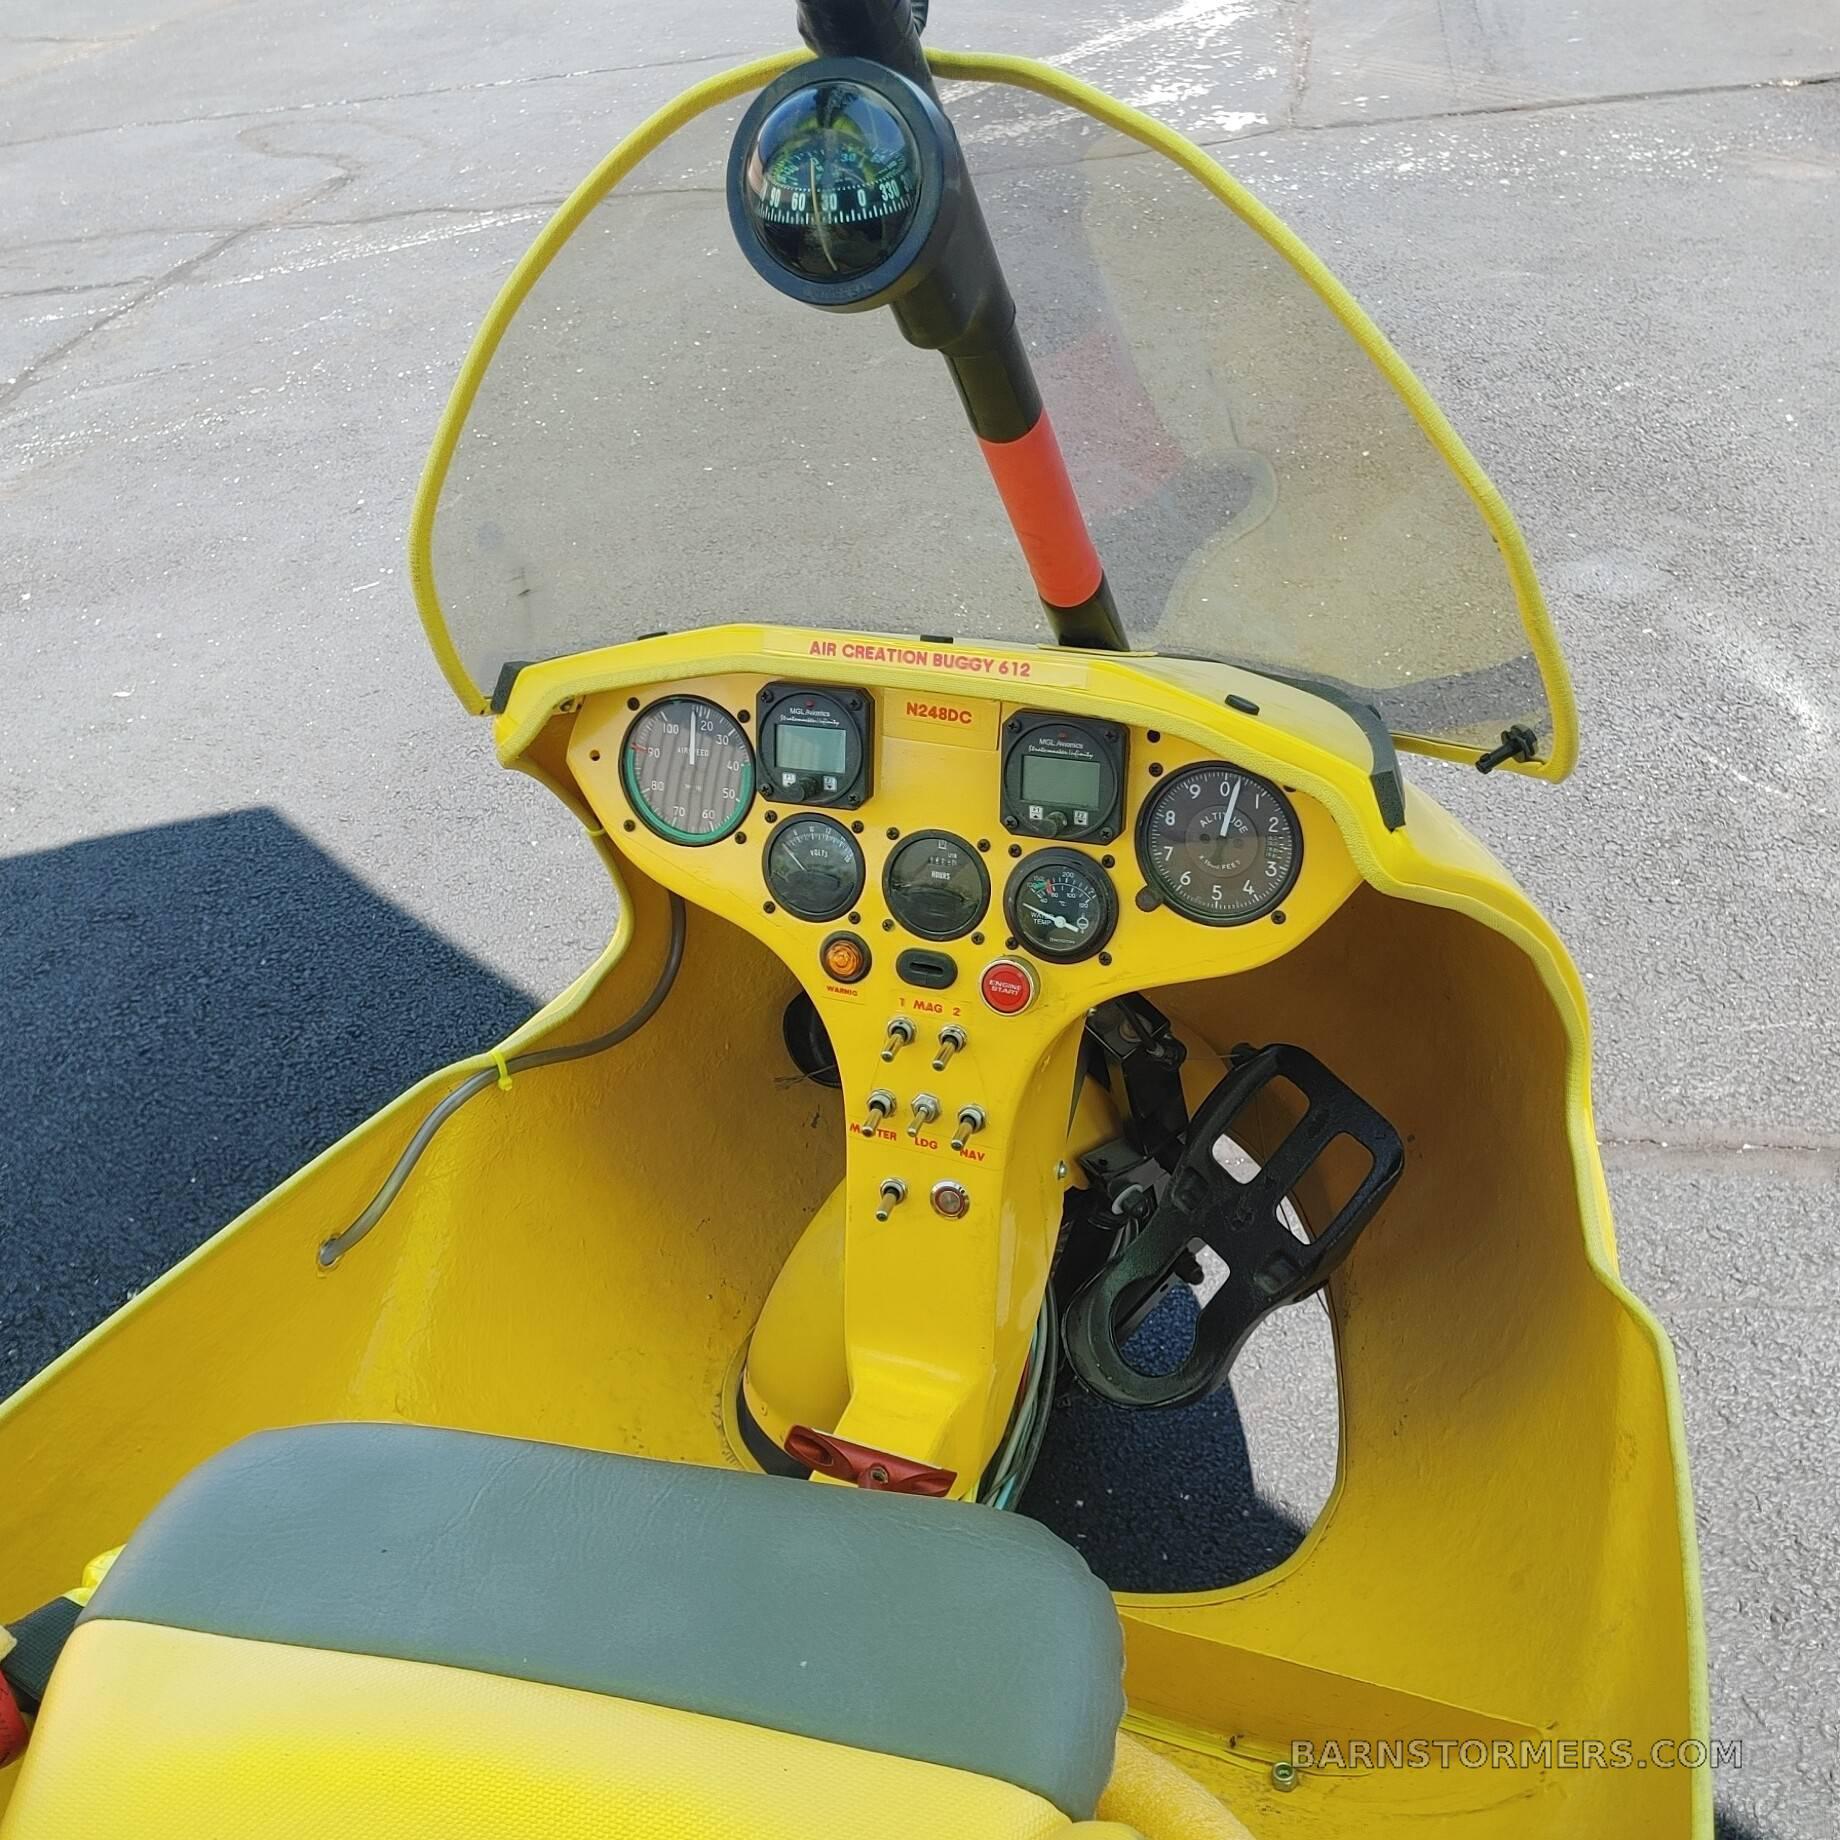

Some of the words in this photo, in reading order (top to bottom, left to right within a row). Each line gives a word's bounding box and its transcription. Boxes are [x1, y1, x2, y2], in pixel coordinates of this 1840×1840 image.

[791, 192, 806, 212] 60
[857, 189, 867, 207] 0
[879, 180, 901, 202] 330
[809, 640, 837, 656] AIR
[841, 643, 928, 666] CREATION
[933, 653, 994, 673] BUGGY
[998, 659, 1031, 677] 612
[789, 707, 804, 715] MGL
[906, 702, 972, 724] N248DC
[662, 722, 679, 734] 100
[700, 720, 714, 731] 20
[715, 734, 729, 746] 30
[1039, 738, 1055, 747] MGL
[648, 748, 661, 758] 90
[678, 746, 709, 757] AIREED
[726, 761, 740, 772] 40
[651, 780, 665, 792] 80
[722, 787, 736, 799] 50
[1189, 784, 1201, 799] 9
[1219, 781, 1231, 797] 0
[1255, 794, 1260, 809] 1
[673, 806, 686, 817] 70
[702, 809, 716, 820] 60
[1165, 810, 1176, 826] 8
[1268, 816, 1279, 833] 2
[1163, 846, 1174, 862] 7
[1265, 861, 1277, 877] 3
[1180, 871, 1191, 886] 6
[1211, 885, 1223, 901] 5
[1242, 879, 1255, 895] 4
[989, 979, 1022, 991] ENGINE
[991, 985, 1019, 996] START
[913, 1000, 943, 1013] MAG
[952, 1007, 961, 1017] 2
[849, 1122, 897, 1141] MTER
[914, 1136, 938, 1150] LDG
[959, 1149, 985, 1162] NAV
